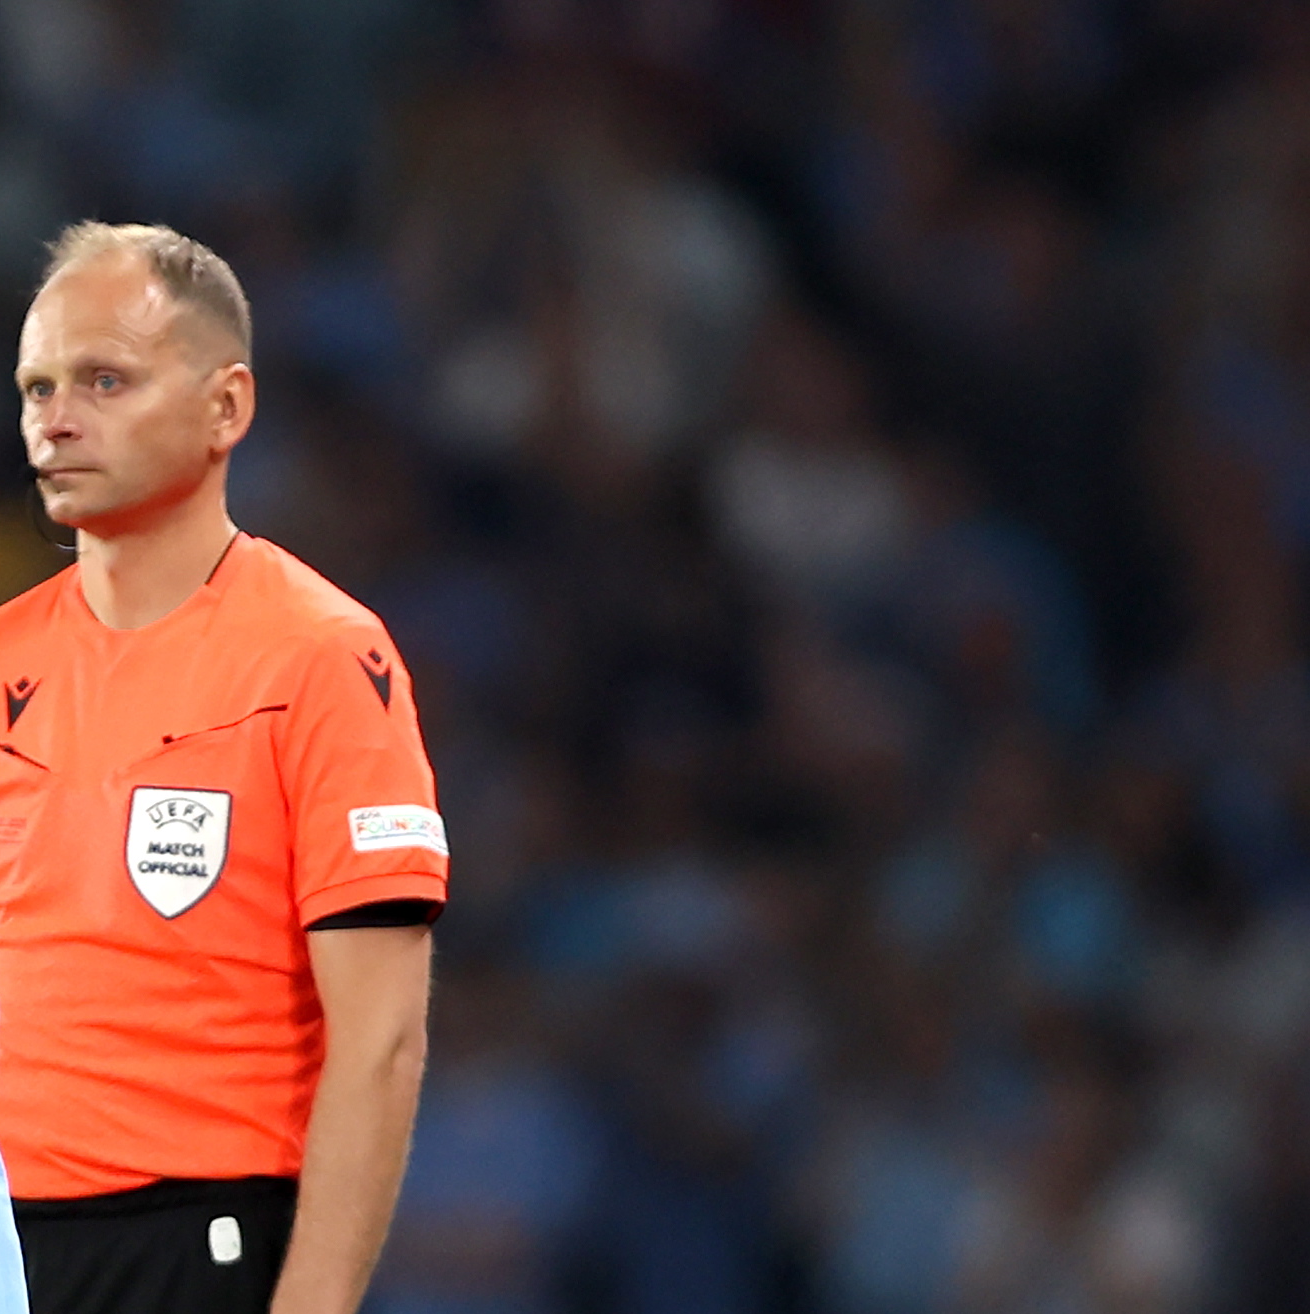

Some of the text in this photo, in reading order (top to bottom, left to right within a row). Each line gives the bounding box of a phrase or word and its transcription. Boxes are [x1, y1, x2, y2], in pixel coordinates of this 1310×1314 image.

[148, 801, 207, 828] UEFA
[146, 841, 205, 857] MATCH
[137, 860, 209, 878] OFFICIAL
